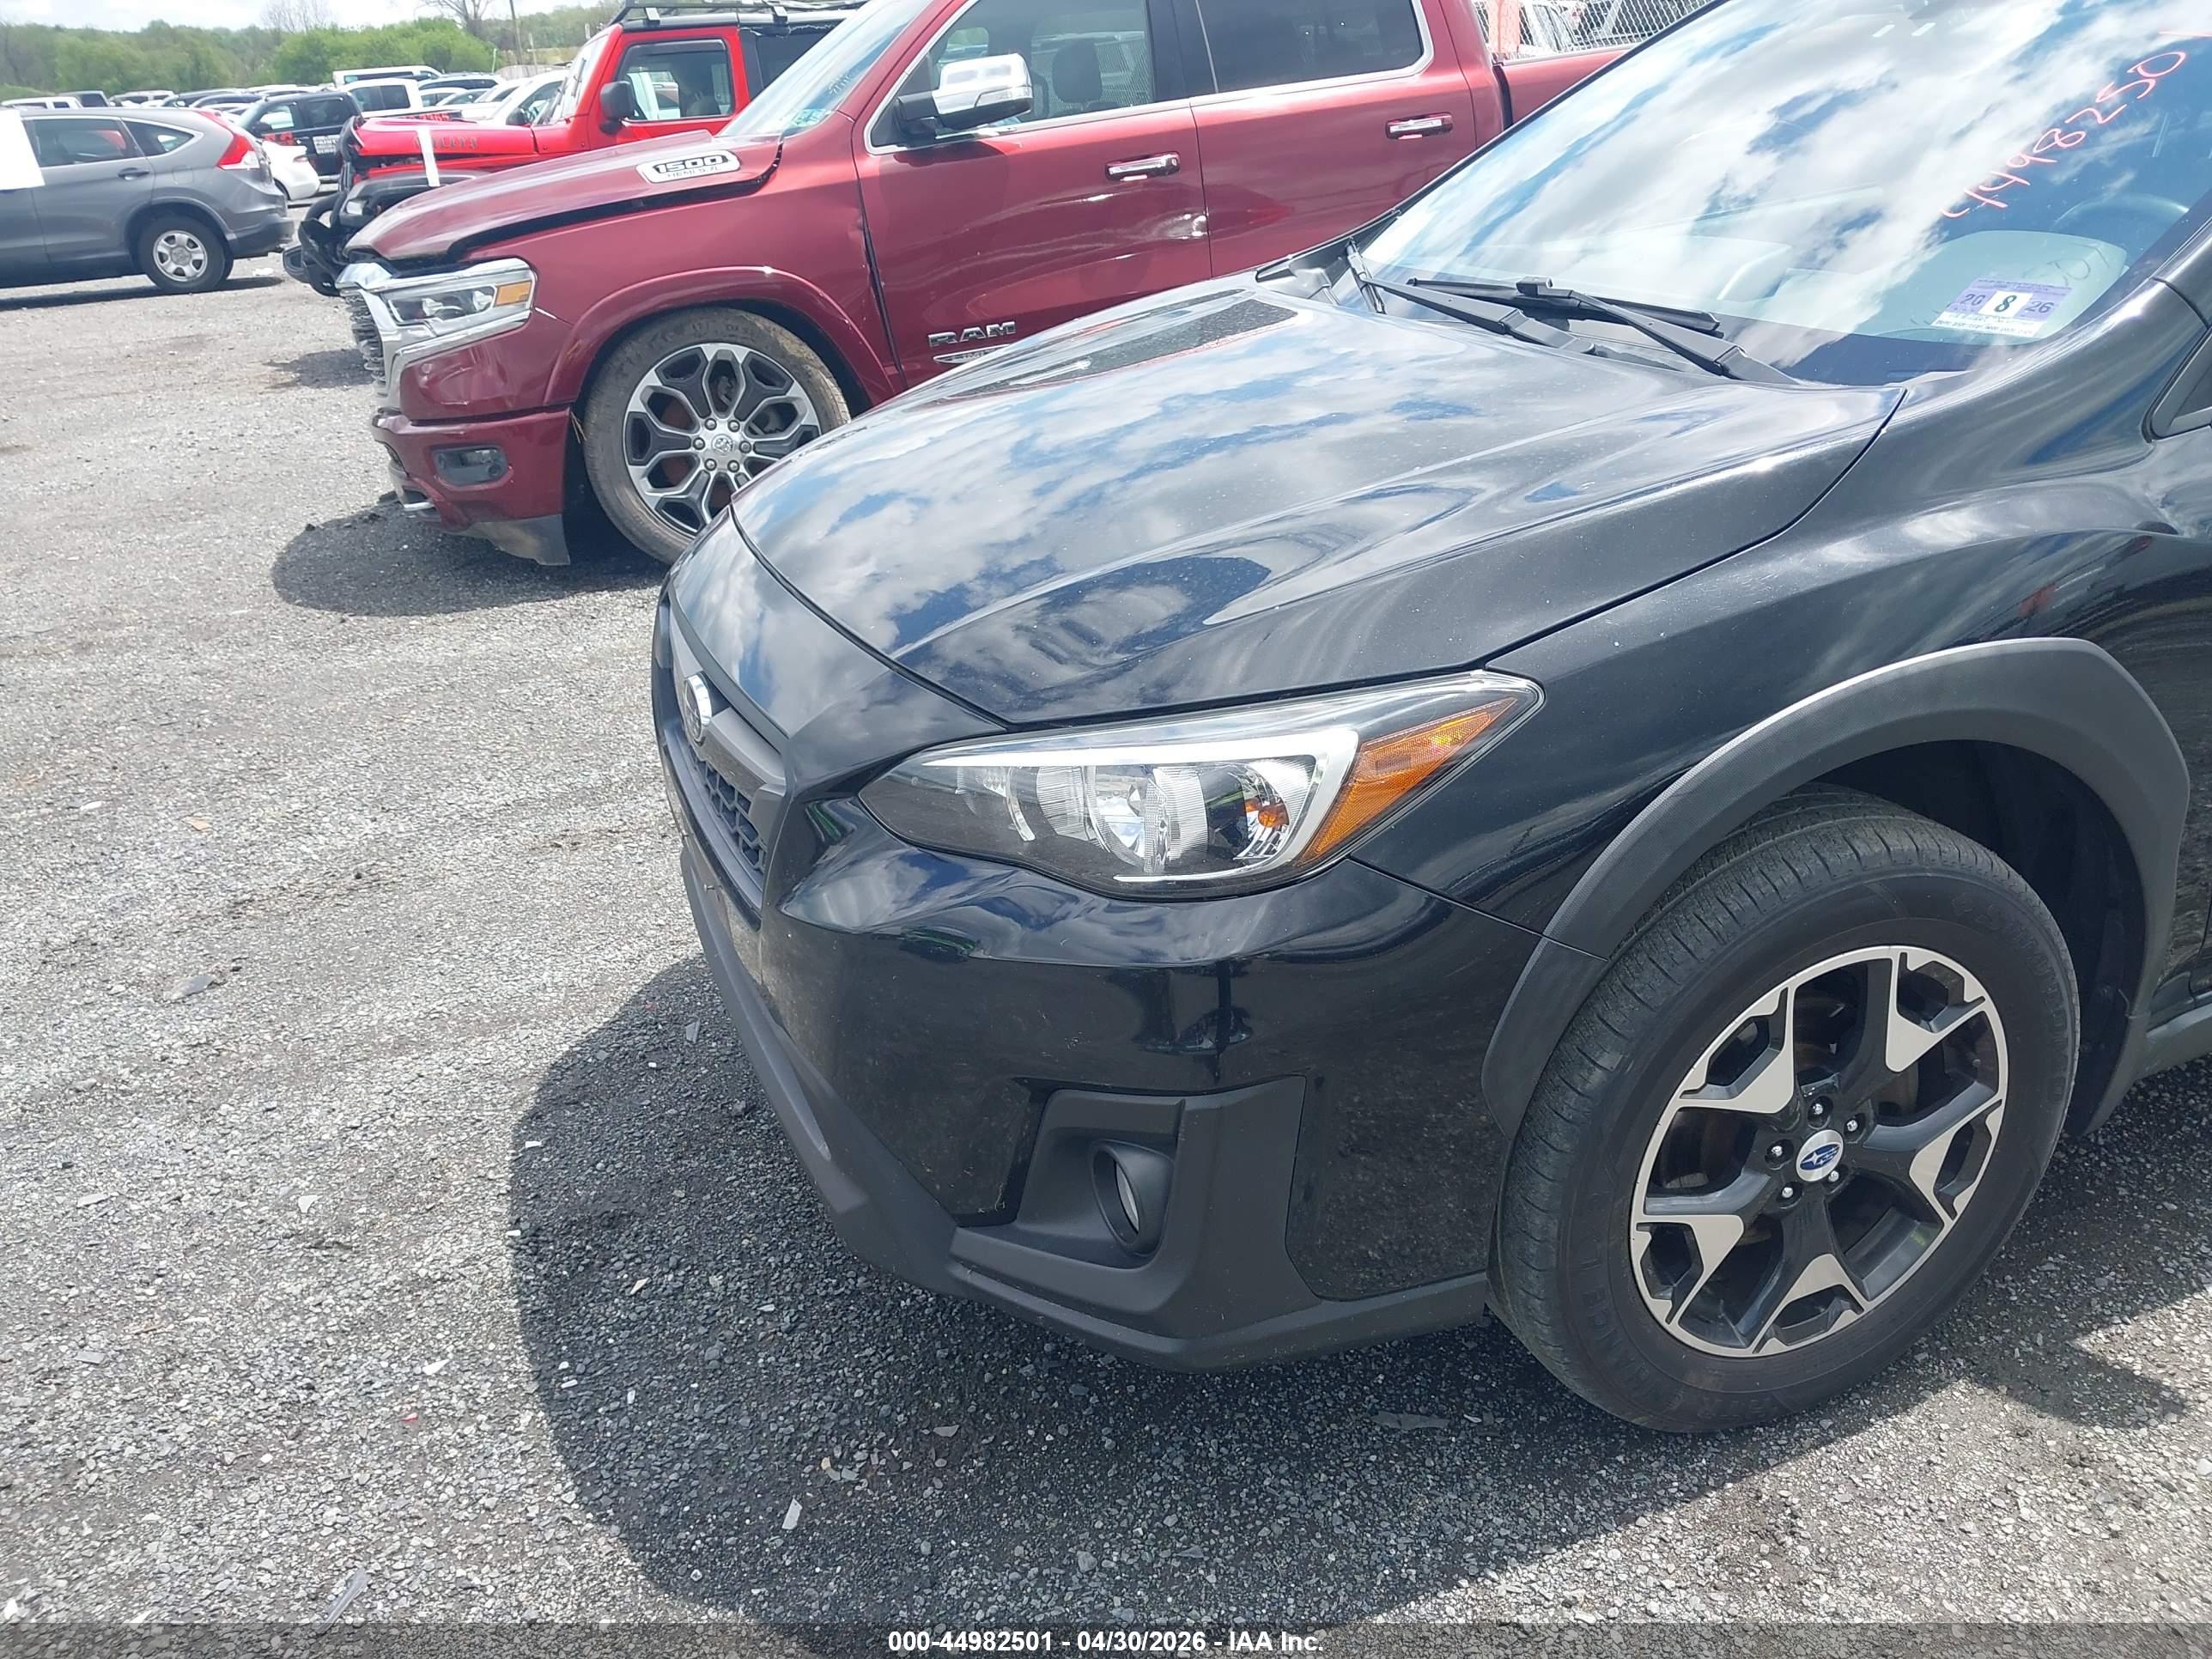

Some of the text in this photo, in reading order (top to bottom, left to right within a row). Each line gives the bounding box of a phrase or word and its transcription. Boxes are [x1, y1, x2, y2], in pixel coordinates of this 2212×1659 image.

[653, 155, 727, 174] 1500
[1993, 294, 2018, 313] 8
[2024, 301, 2055, 314] 26
[927, 321, 1017, 348] RAM
